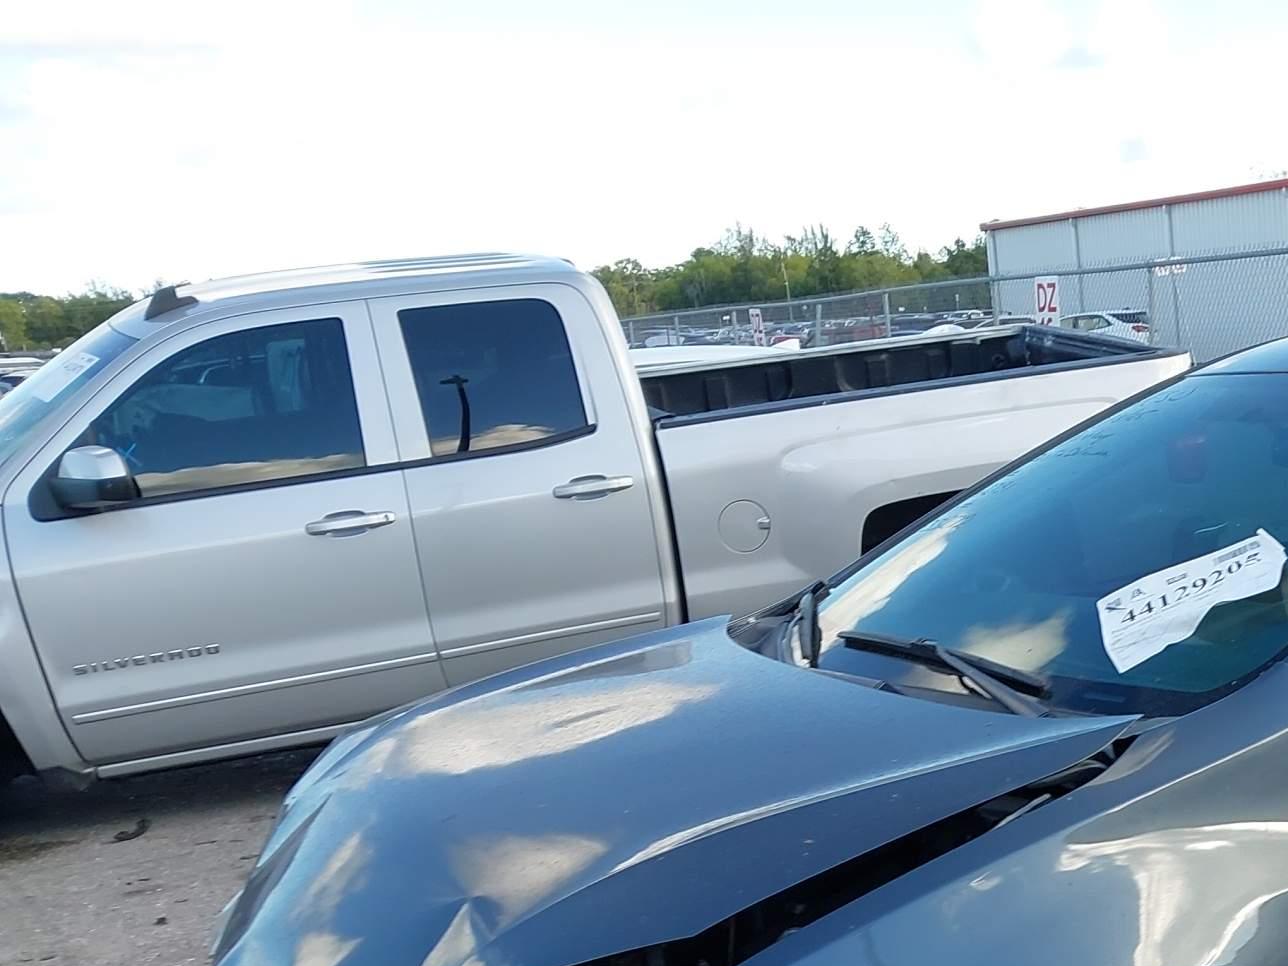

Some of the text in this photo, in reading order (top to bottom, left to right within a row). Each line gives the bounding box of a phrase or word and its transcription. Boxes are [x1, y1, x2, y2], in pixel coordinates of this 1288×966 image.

[1036, 282, 1057, 313] DZ
[1120, 551, 1263, 624] 44129205
[72, 643, 221, 676] SILVERADO
